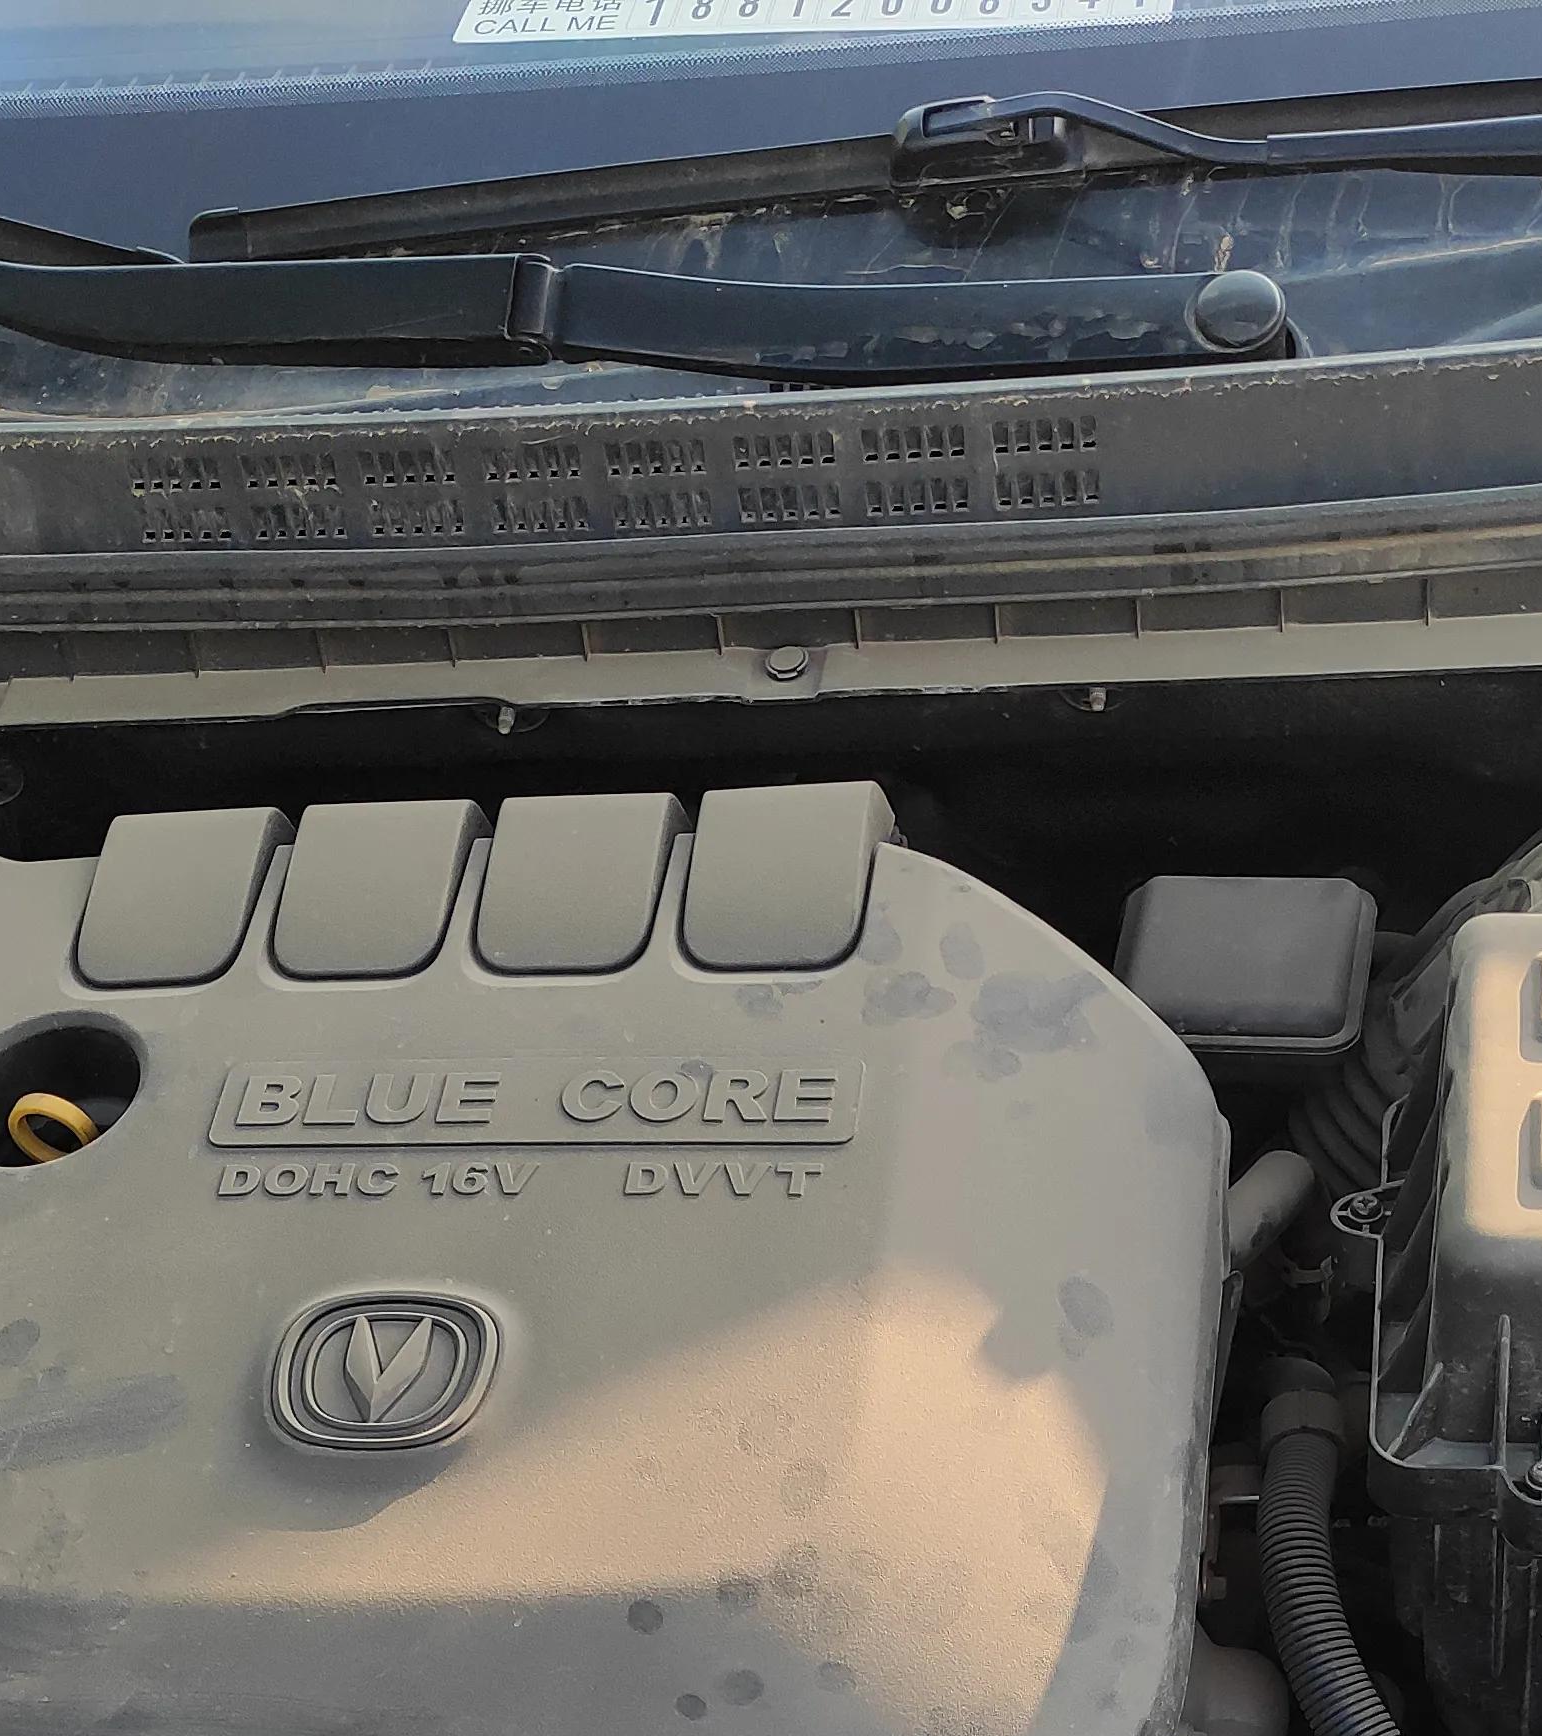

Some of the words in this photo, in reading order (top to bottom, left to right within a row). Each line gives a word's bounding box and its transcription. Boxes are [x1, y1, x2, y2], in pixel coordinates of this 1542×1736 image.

[473, 16, 556, 35] CALL
[566, 14, 619, 32] ME
[234, 1070, 503, 1127] BLUE
[560, 1068, 838, 1123] CORE
[217, 1162, 400, 1197] DOHC
[420, 1161, 540, 1196] 16V
[623, 1160, 825, 1198] DVVT
